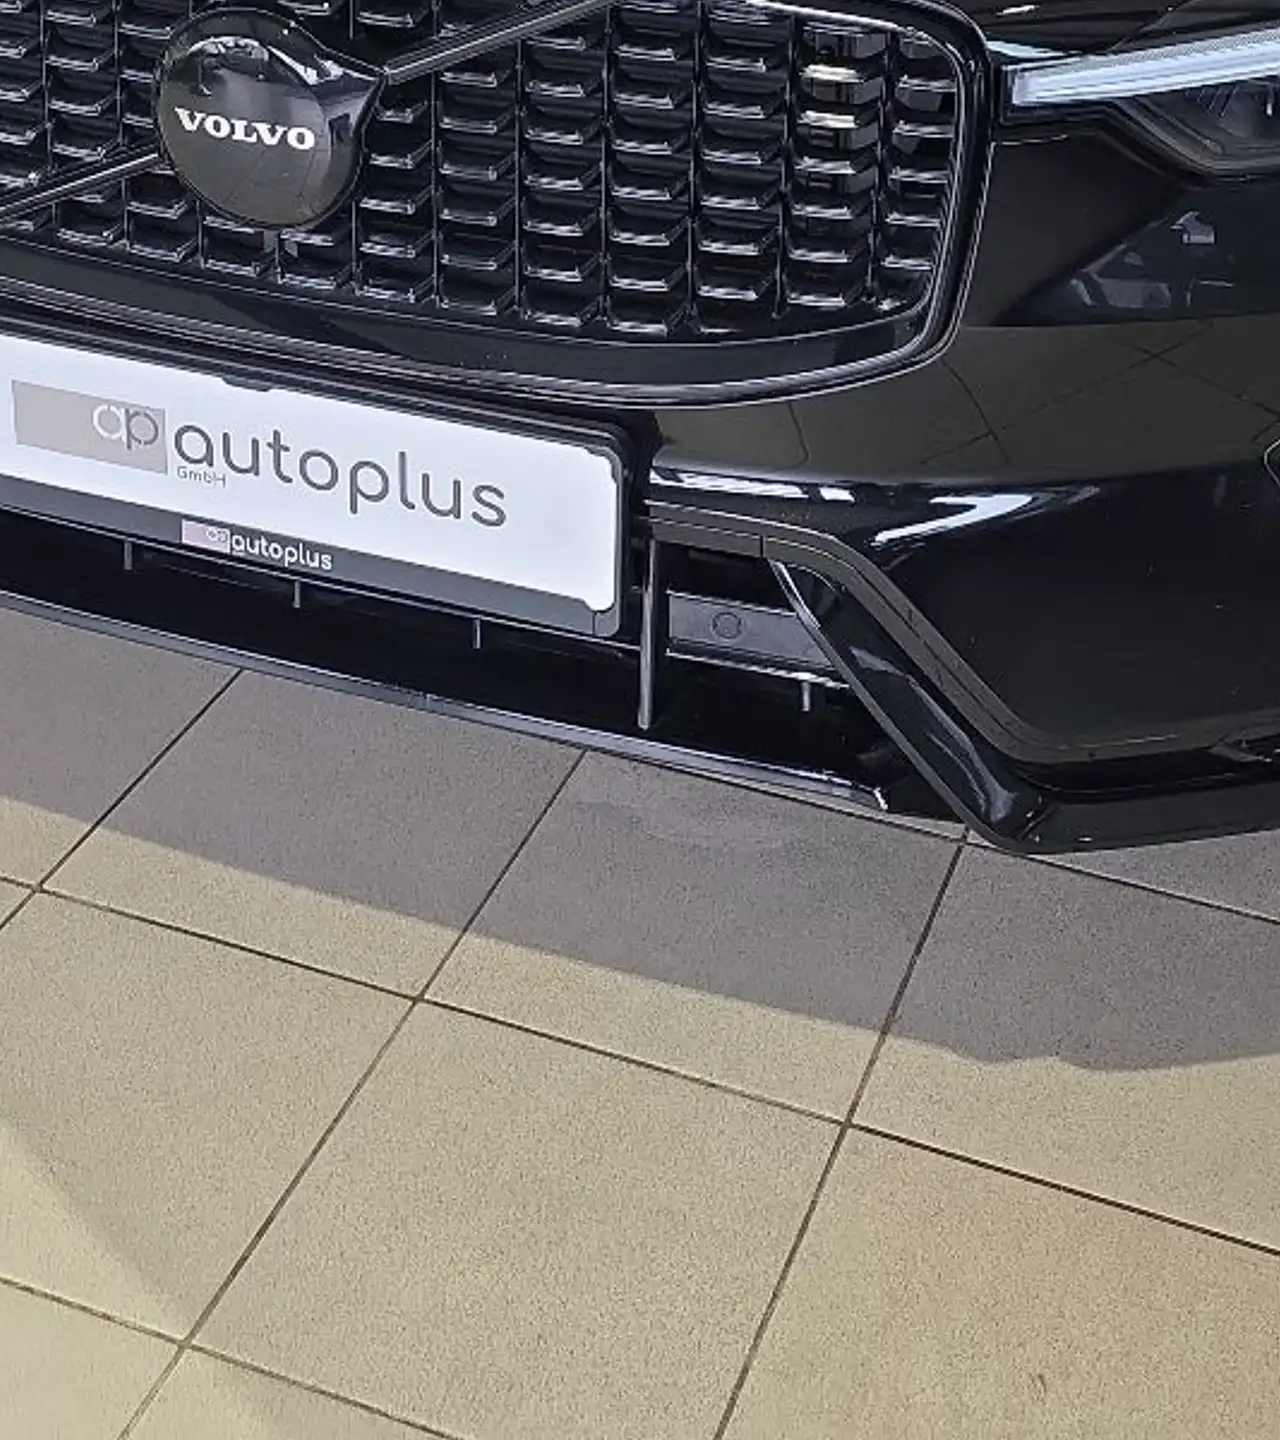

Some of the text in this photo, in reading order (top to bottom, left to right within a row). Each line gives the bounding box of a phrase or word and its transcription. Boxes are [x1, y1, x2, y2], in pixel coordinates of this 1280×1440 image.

[174, 106, 316, 151] VOLVO
[174, 424, 507, 528] autoplus
[176, 465, 227, 489] GmbH
[231, 534, 333, 571] autoplus
